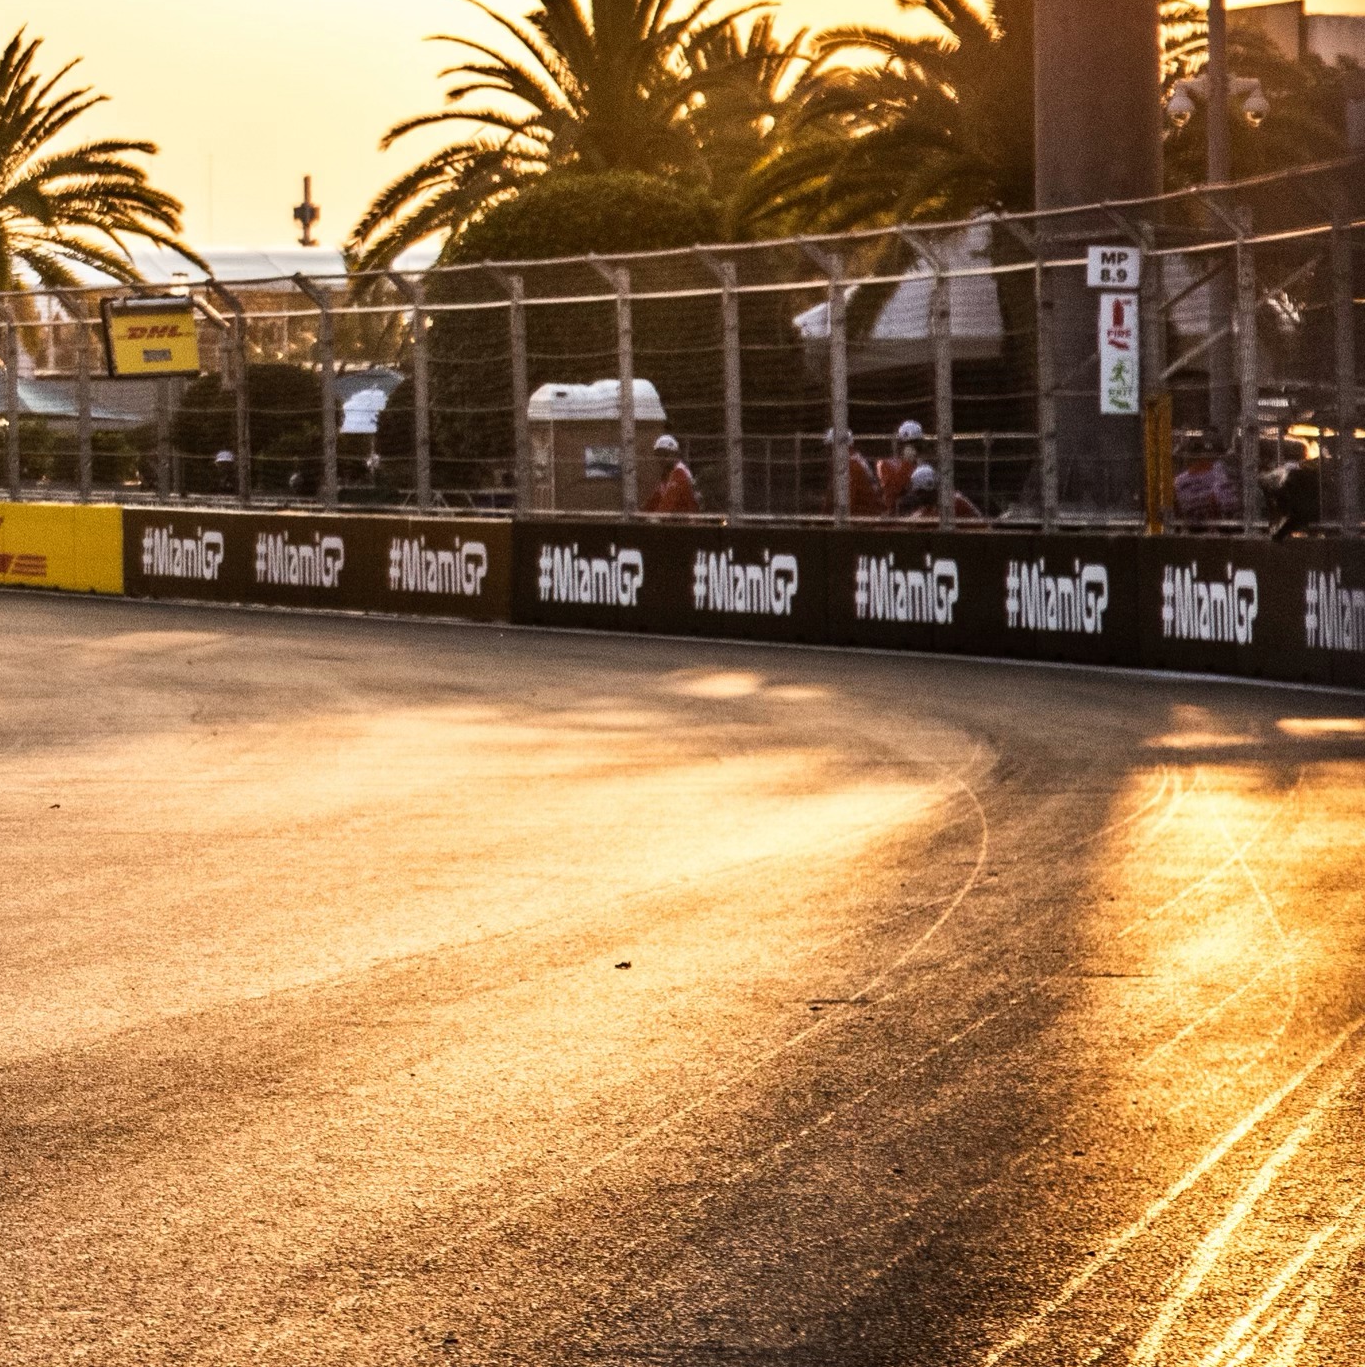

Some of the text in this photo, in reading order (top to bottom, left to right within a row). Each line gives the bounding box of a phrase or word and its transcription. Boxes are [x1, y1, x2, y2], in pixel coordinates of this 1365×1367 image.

[1100, 252, 1129, 265] MP
[1100, 269, 1128, 283] 8.9
[127, 325, 182, 340] DHL
